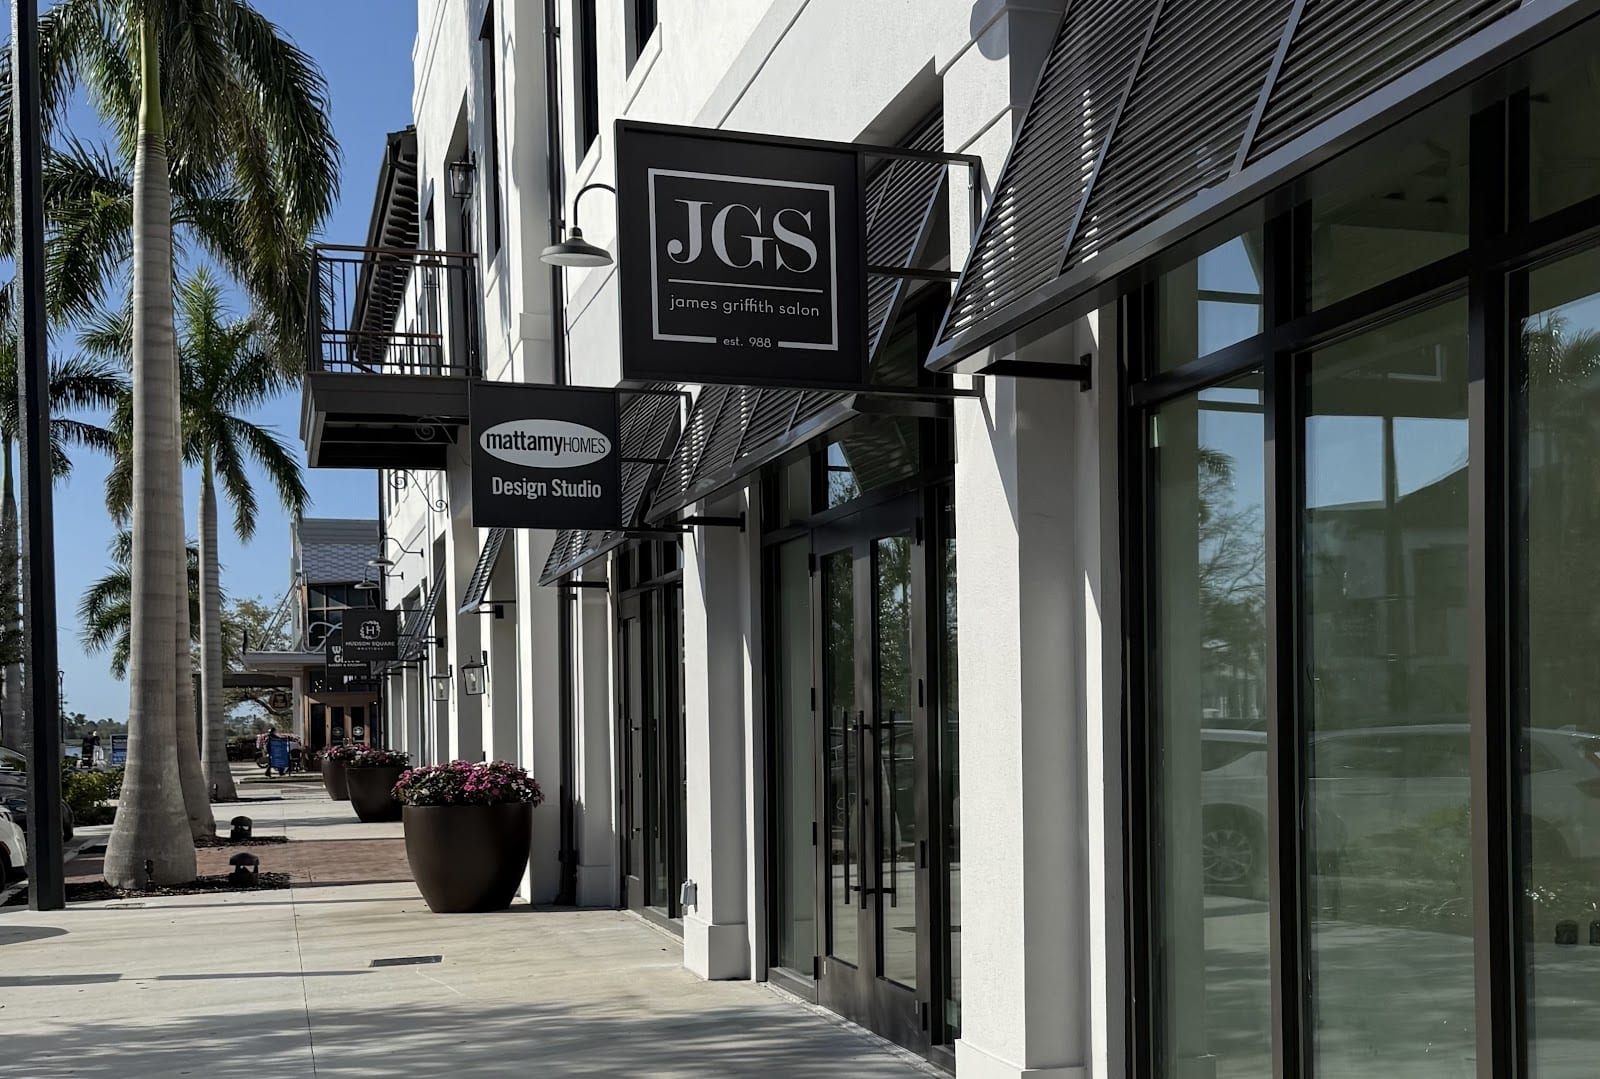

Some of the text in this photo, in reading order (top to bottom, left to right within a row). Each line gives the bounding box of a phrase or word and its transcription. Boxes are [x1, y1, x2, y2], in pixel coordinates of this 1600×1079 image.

[666, 199, 818, 273] JGS
[669, 294, 819, 317] james griffith salon
[723, 336, 772, 348] est. 988
[492, 476, 602, 500] Design Studio
